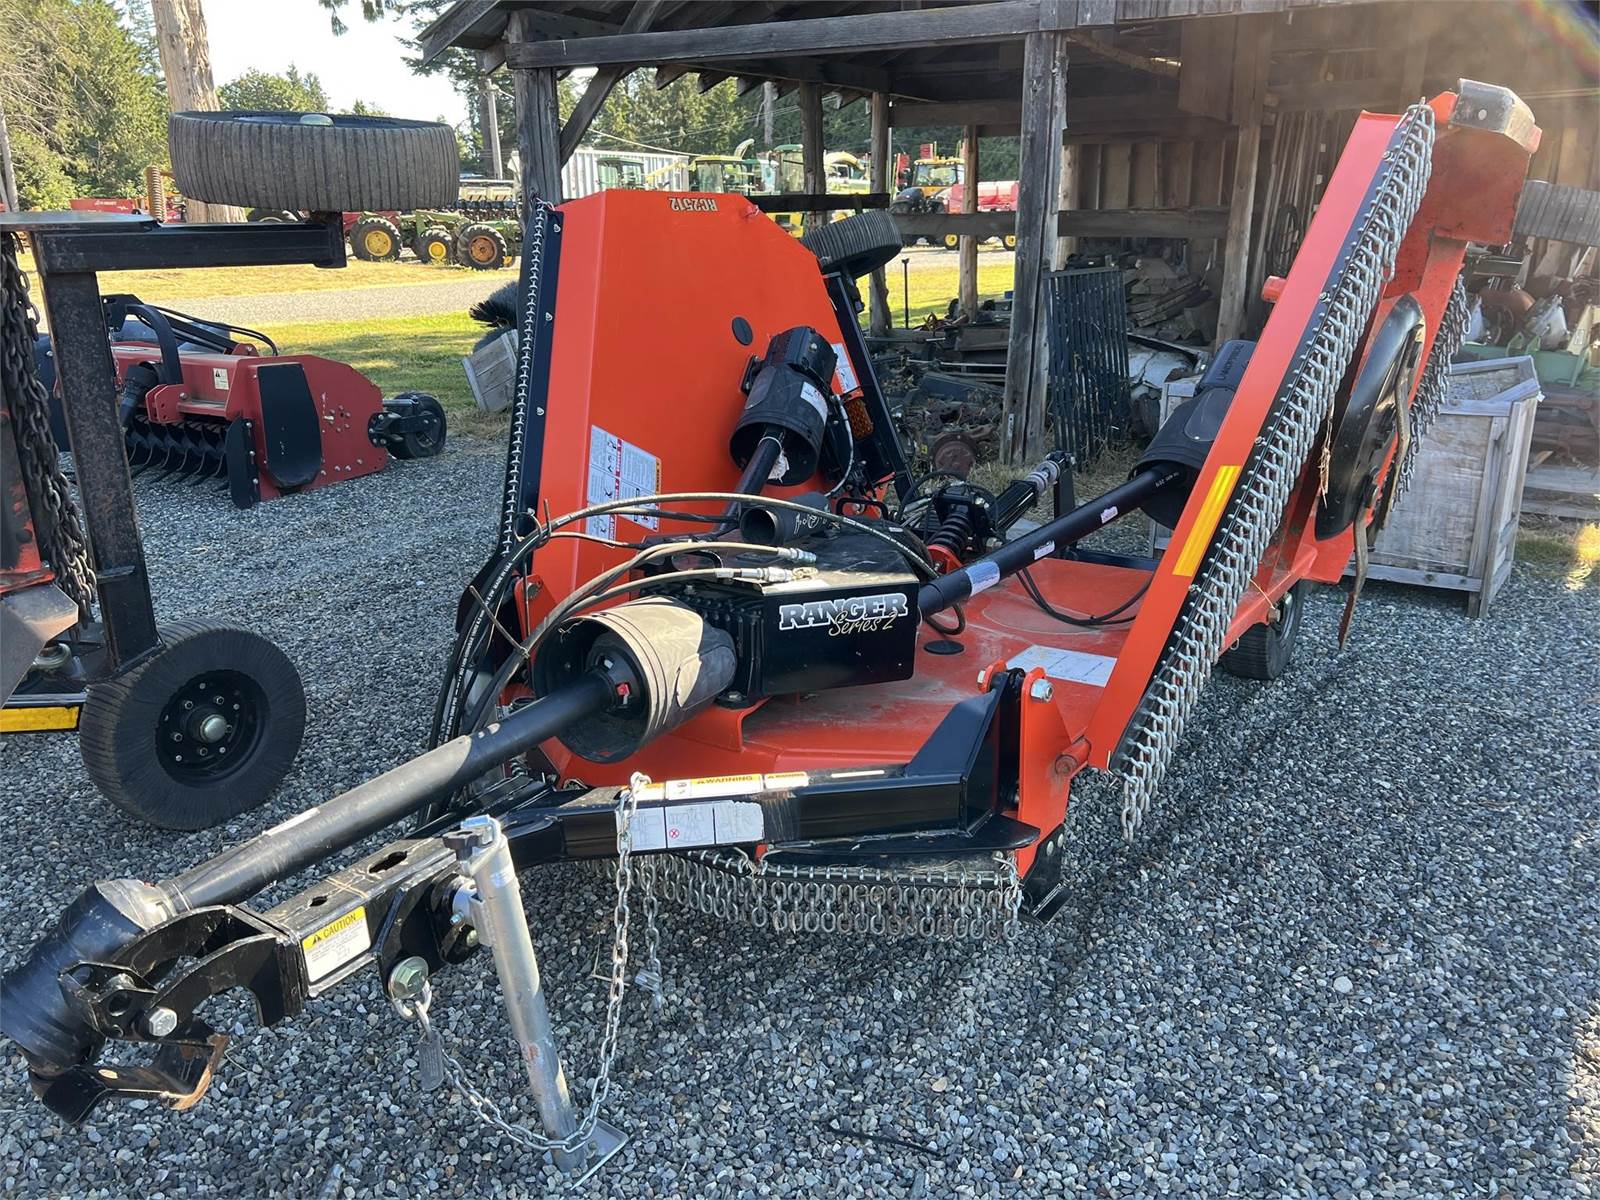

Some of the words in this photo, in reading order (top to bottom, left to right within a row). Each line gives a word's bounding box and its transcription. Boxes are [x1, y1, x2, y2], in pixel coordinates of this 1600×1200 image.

[668, 196, 719, 212] RC2512
[779, 593, 908, 630] RANGER
[828, 610, 882, 636] Series
[882, 611, 898, 630] 2
[323, 914, 357, 938] CAUTION
